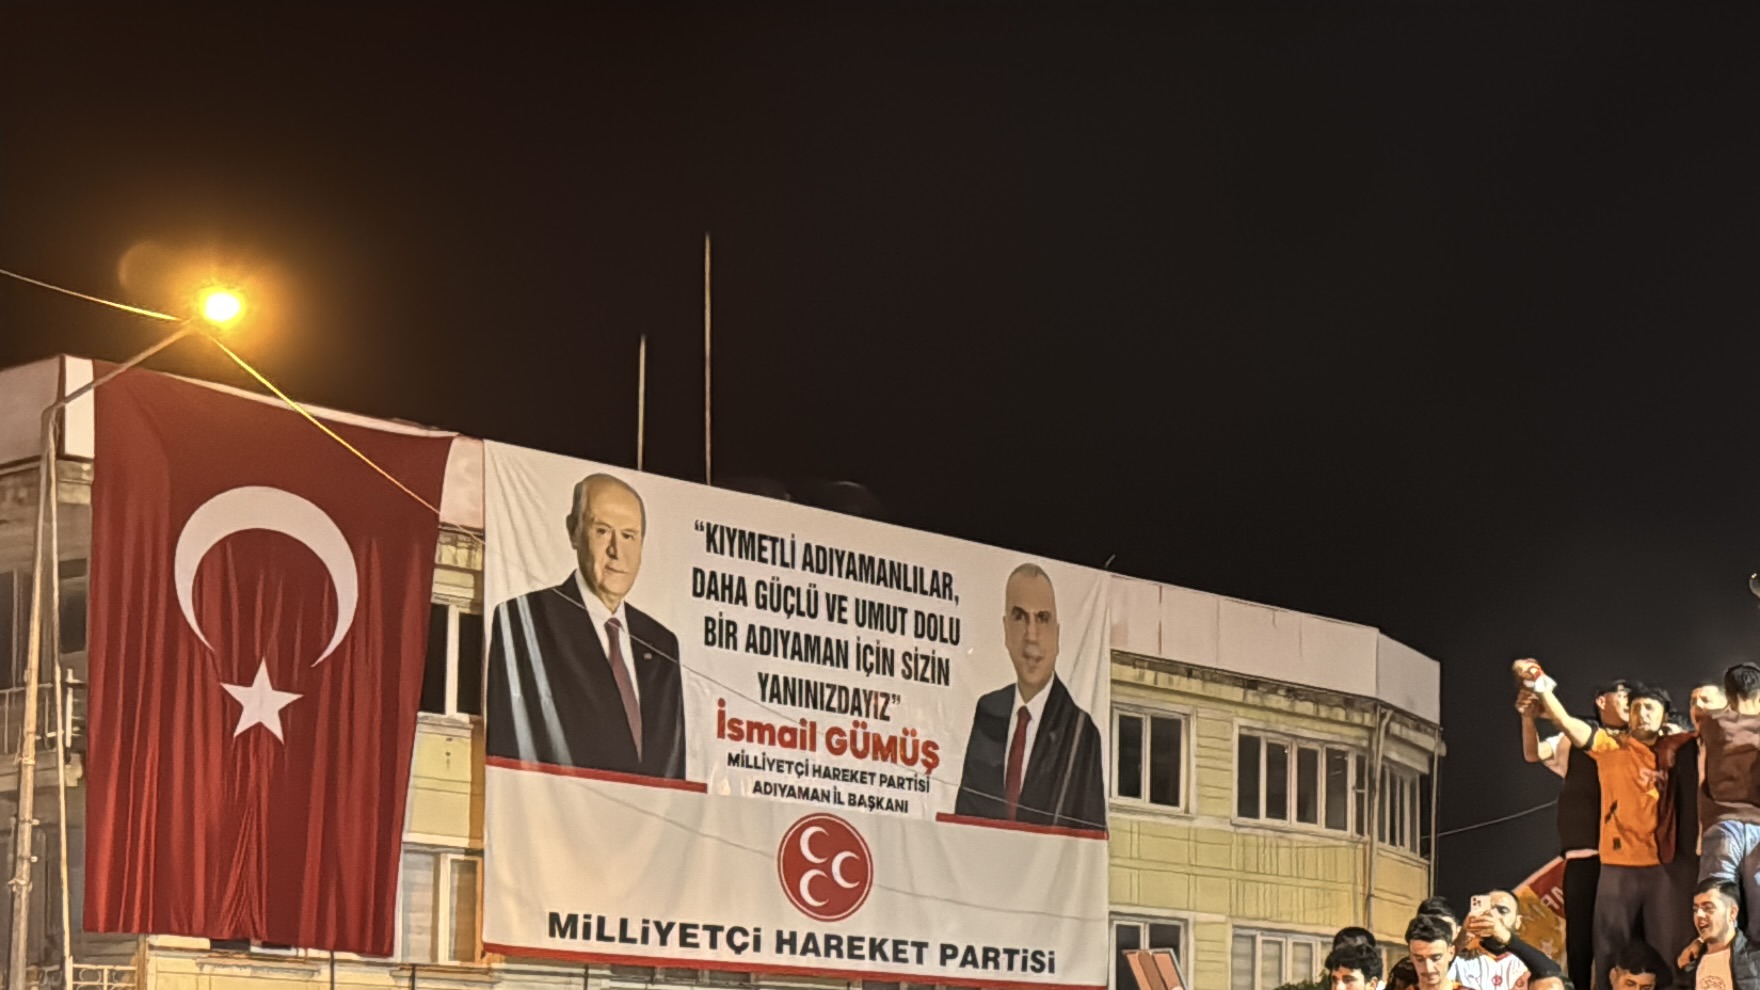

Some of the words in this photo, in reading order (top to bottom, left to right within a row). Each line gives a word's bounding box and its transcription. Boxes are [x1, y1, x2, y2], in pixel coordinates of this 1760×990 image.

[694, 519, 796, 569] “KIYMETLİ
[801, 542, 960, 607] ADIYAMANLILAR,
[692, 566, 748, 608] DAHA
[754, 576, 819, 620] GÜÇLÜ
[825, 591, 848, 624] VE
[855, 597, 908, 636] UMUT
[914, 609, 960, 646] DOLU
[704, 611, 738, 651] BİR
[745, 623, 849, 670] ADIYAMAN
[856, 636, 895, 678] İÇİN
[901, 646, 950, 687] SİZİN
[757, 671, 901, 722] YANINIZDAYIZ”
[716, 697, 817, 753] İsmail
[825, 719, 940, 775] GÜMÜŞ
[727, 749, 809, 778] MİLLİYETÇİ
[812, 764, 876, 786] HAREKET
[879, 773, 931, 793] PARTİSİ
[752, 780, 830, 803] ADIYAMAN
[833, 785, 844, 806] İL
[848, 792, 909, 814] BAŞKANI
[775, 929, 930, 966] HAREKET
